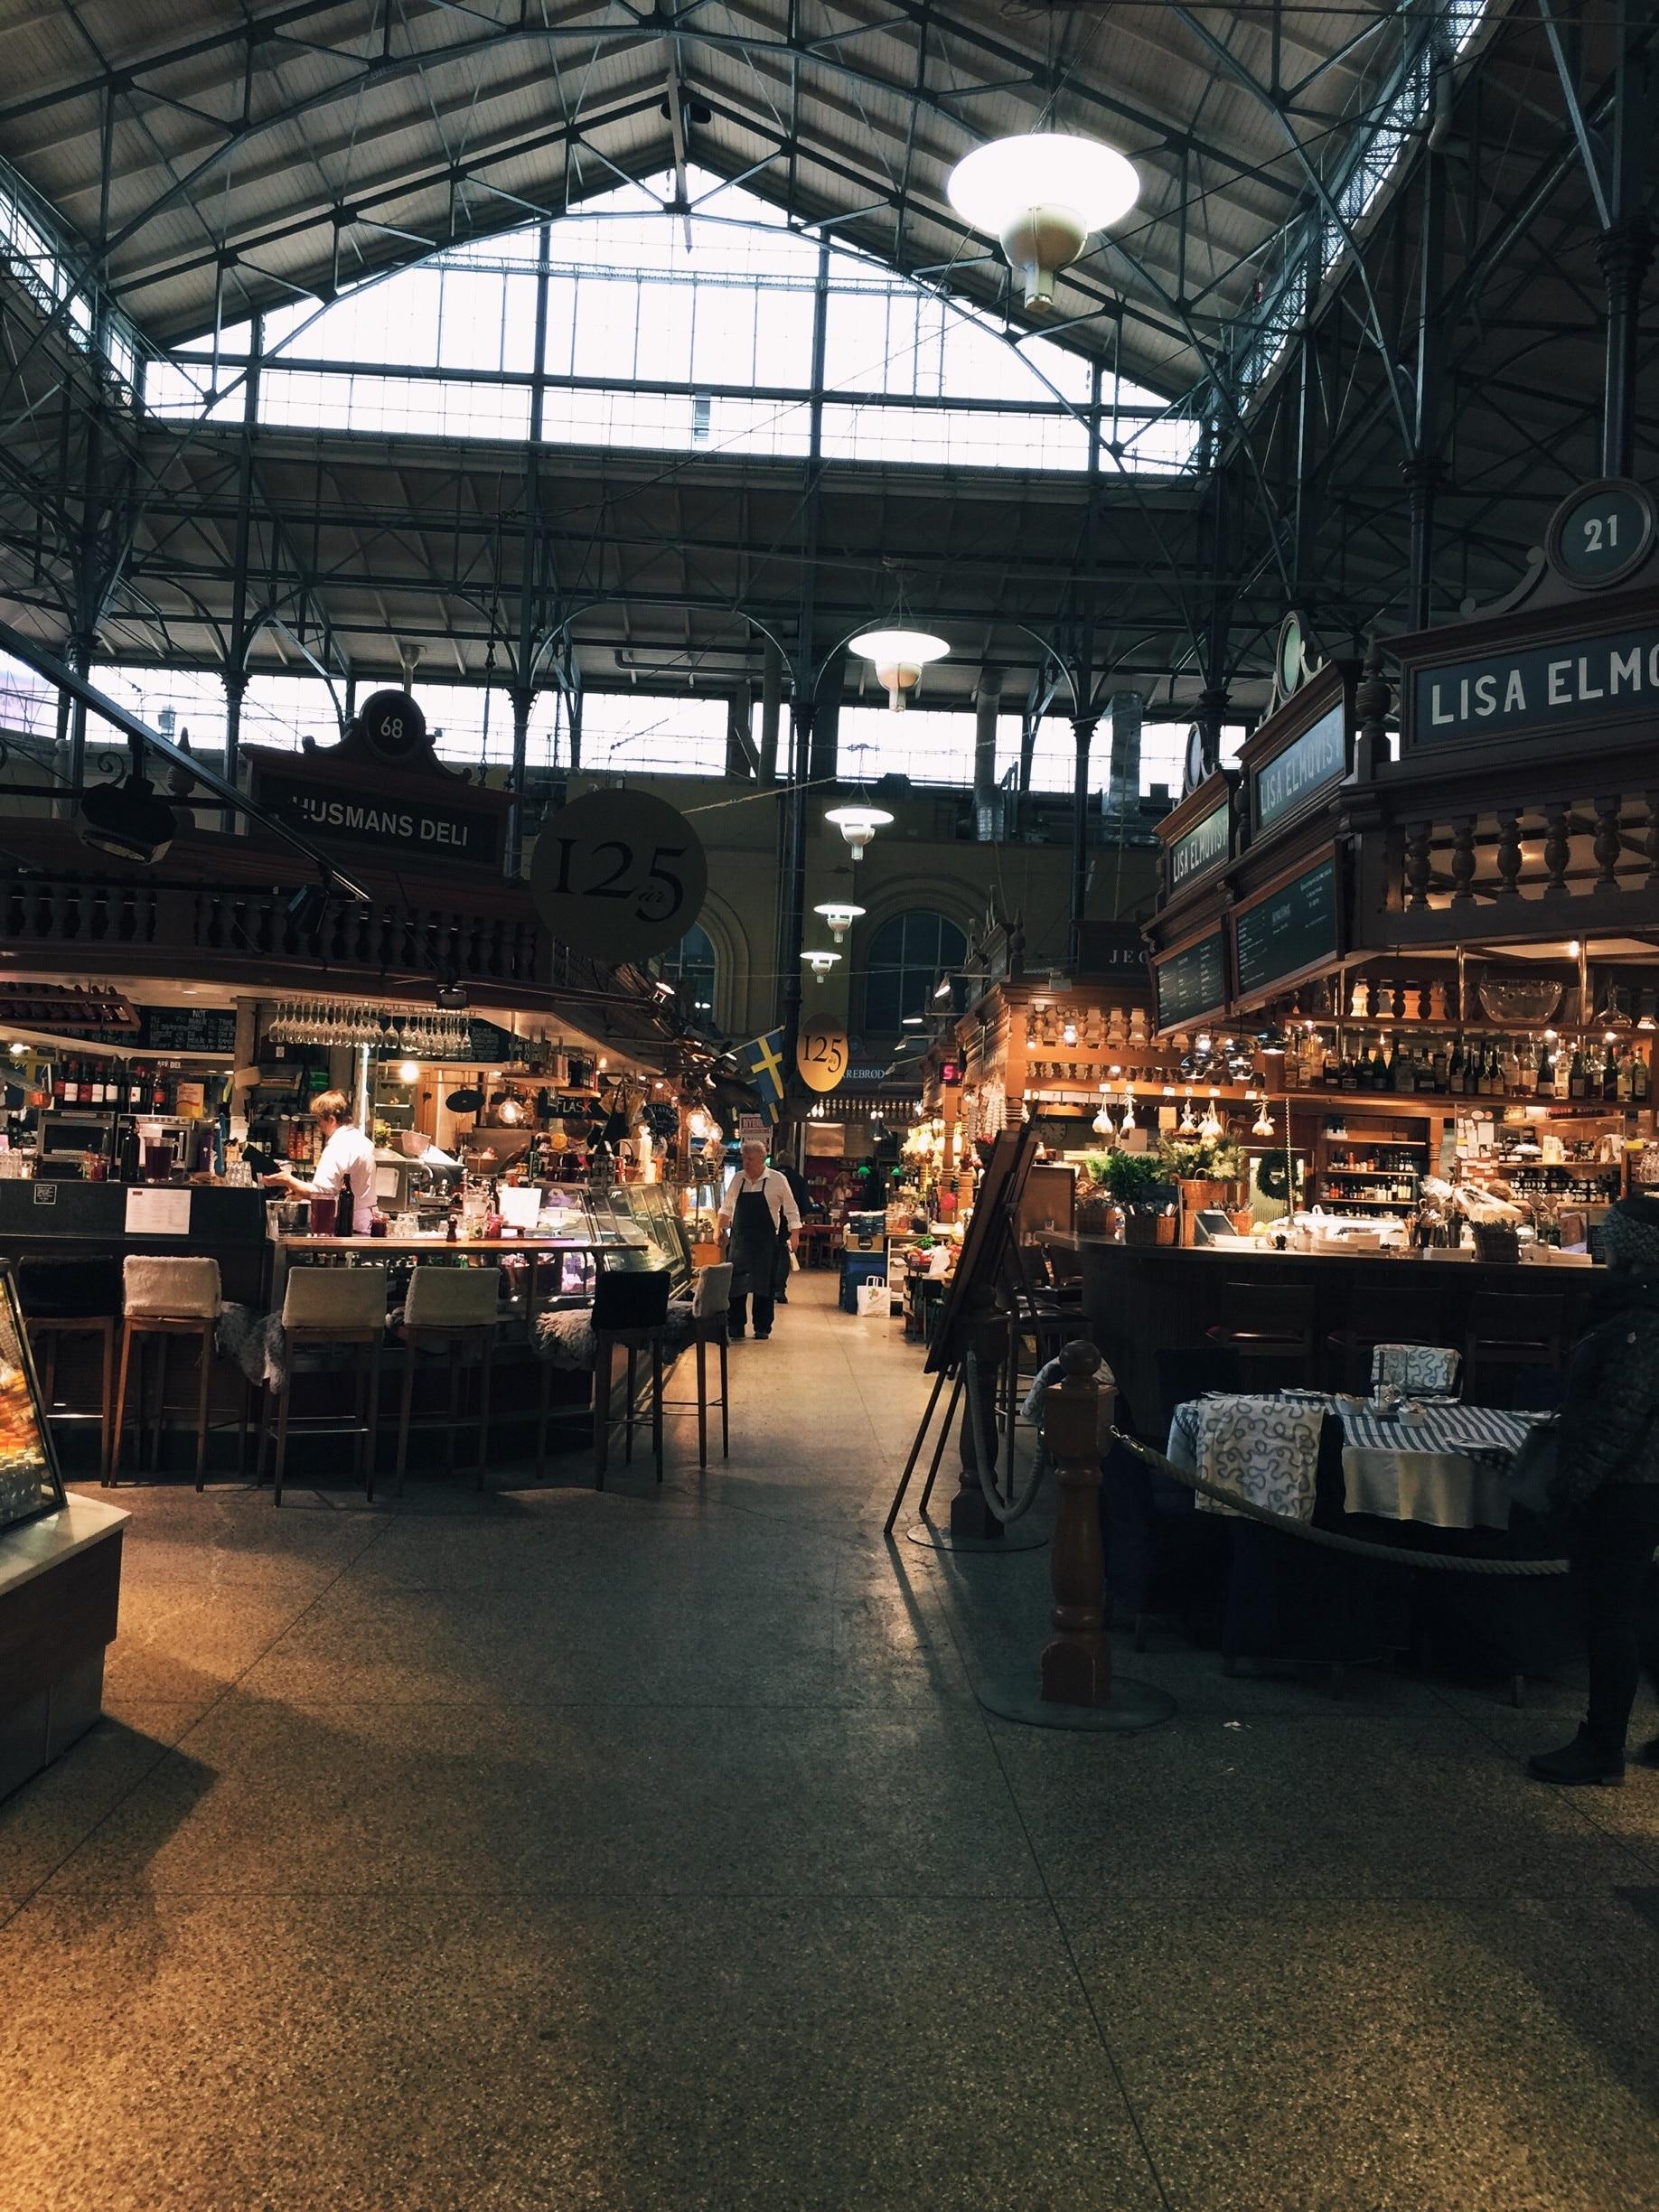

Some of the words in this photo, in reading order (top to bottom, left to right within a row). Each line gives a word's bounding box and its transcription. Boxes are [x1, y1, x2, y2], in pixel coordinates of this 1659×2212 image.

[1584, 514, 1617, 552] 21
[1431, 669, 1527, 726] LISA
[380, 716, 404, 739] 68
[1261, 769, 1282, 816] LISA
[420, 818, 469, 847] DELI
[549, 837, 688, 923] 125
[1174, 847, 1189, 883] LISA
[803, 1035, 842, 1073] 125
[843, 1069, 886, 1080] REBRØD
[556, 1097, 592, 1113] FLÄSK
